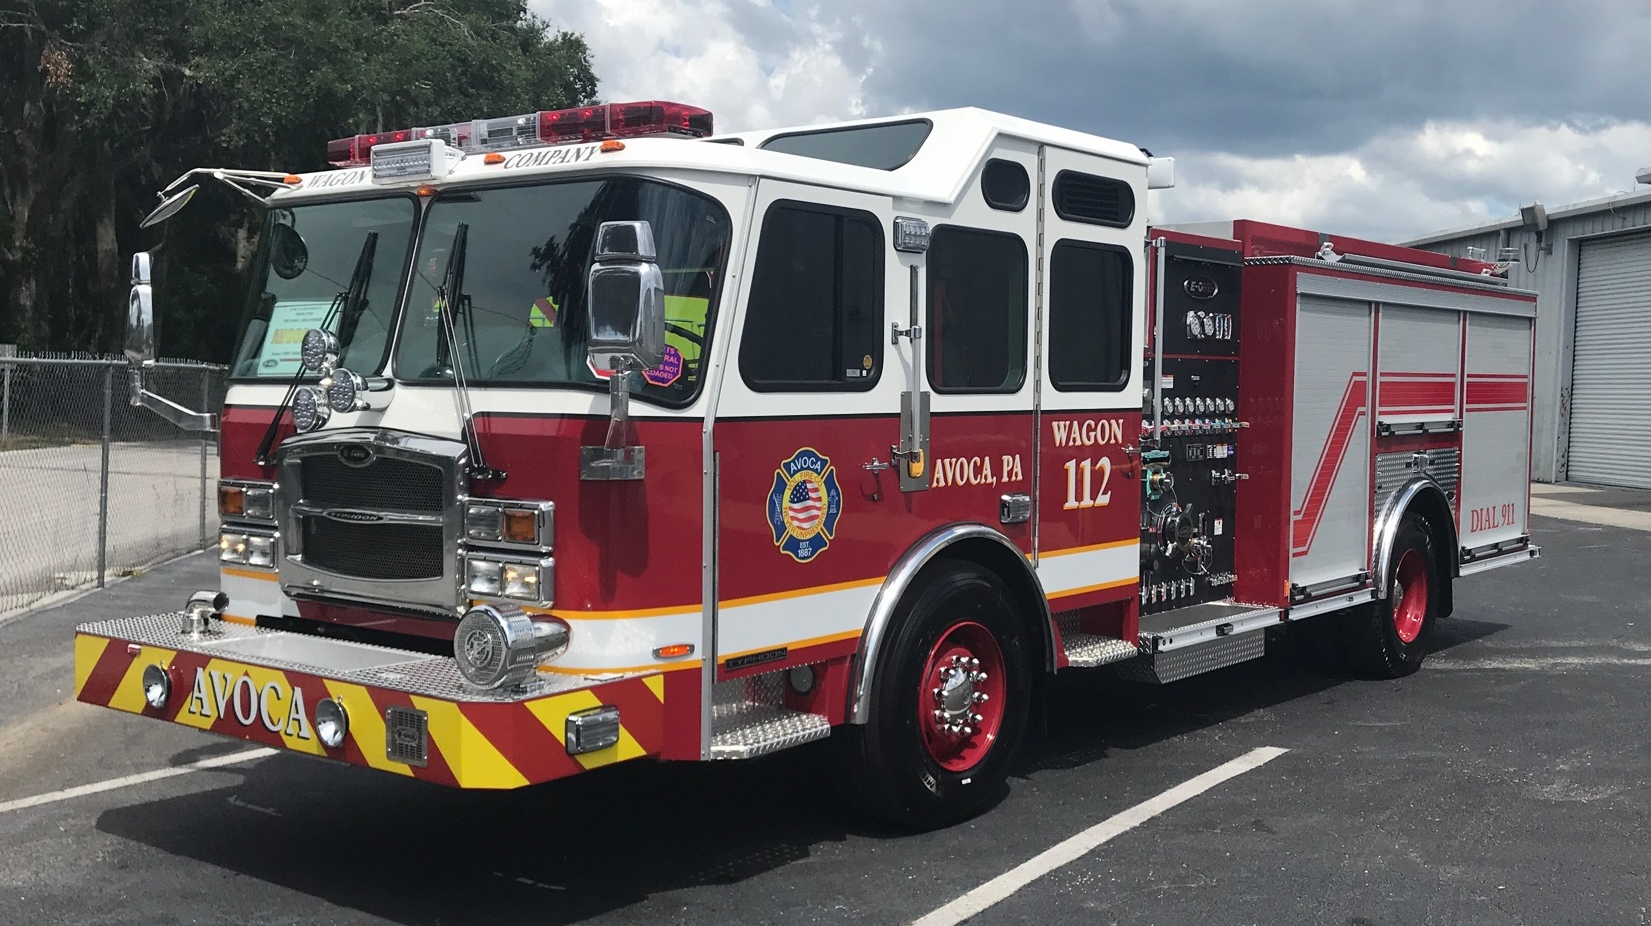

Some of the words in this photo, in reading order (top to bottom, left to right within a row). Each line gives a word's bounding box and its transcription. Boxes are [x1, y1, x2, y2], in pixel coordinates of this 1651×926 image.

[307, 170, 372, 188] WAGON
[503, 146, 601, 169] COMPANY
[1051, 419, 1124, 447] WAGON
[790, 456, 821, 475] AVOCA
[931, 455, 998, 489] AVOCA,
[1001, 454, 1024, 483] PA
[1063, 456, 1112, 510] 112
[331, 512, 379, 521] TYPHOON
[783, 507, 797, 534] NEVER
[1470, 506, 1499, 533] DIAL
[1501, 503, 1515, 526] 911
[797, 548, 812, 558] 1887
[799, 541, 811, 549] EST.
[728, 649, 787, 667] TYPHOON
[188, 667, 310, 740] AVOCA
